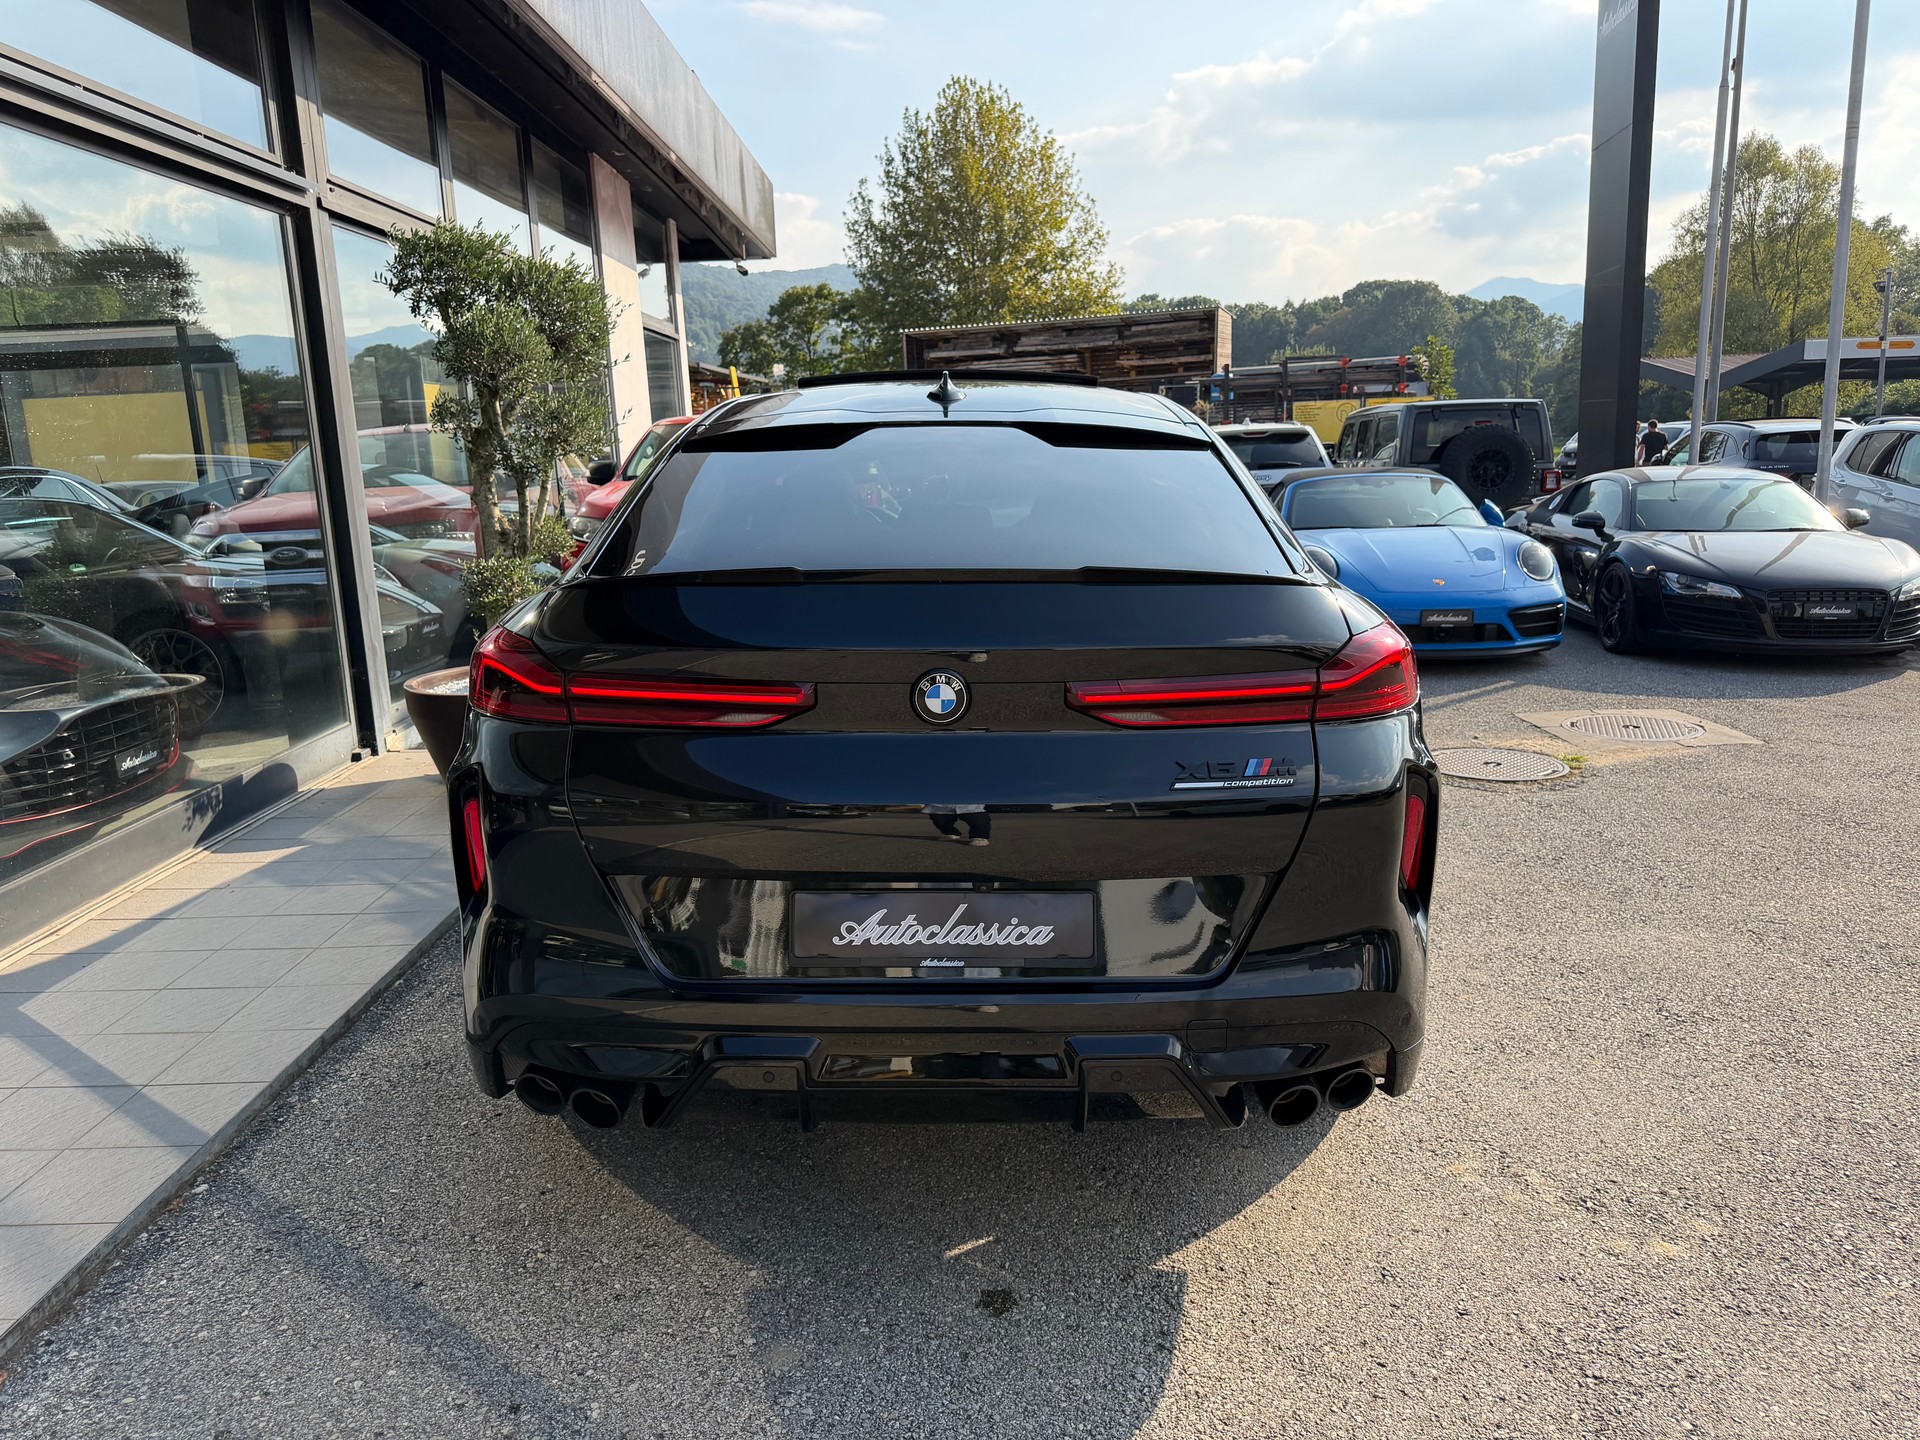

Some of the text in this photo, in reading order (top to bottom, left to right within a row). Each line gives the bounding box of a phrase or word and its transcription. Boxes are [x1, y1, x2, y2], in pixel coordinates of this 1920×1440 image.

[921, 675, 962, 692] BMW
[1224, 778, 1294, 787] competition
[832, 904, 1054, 946] Autoclassica
